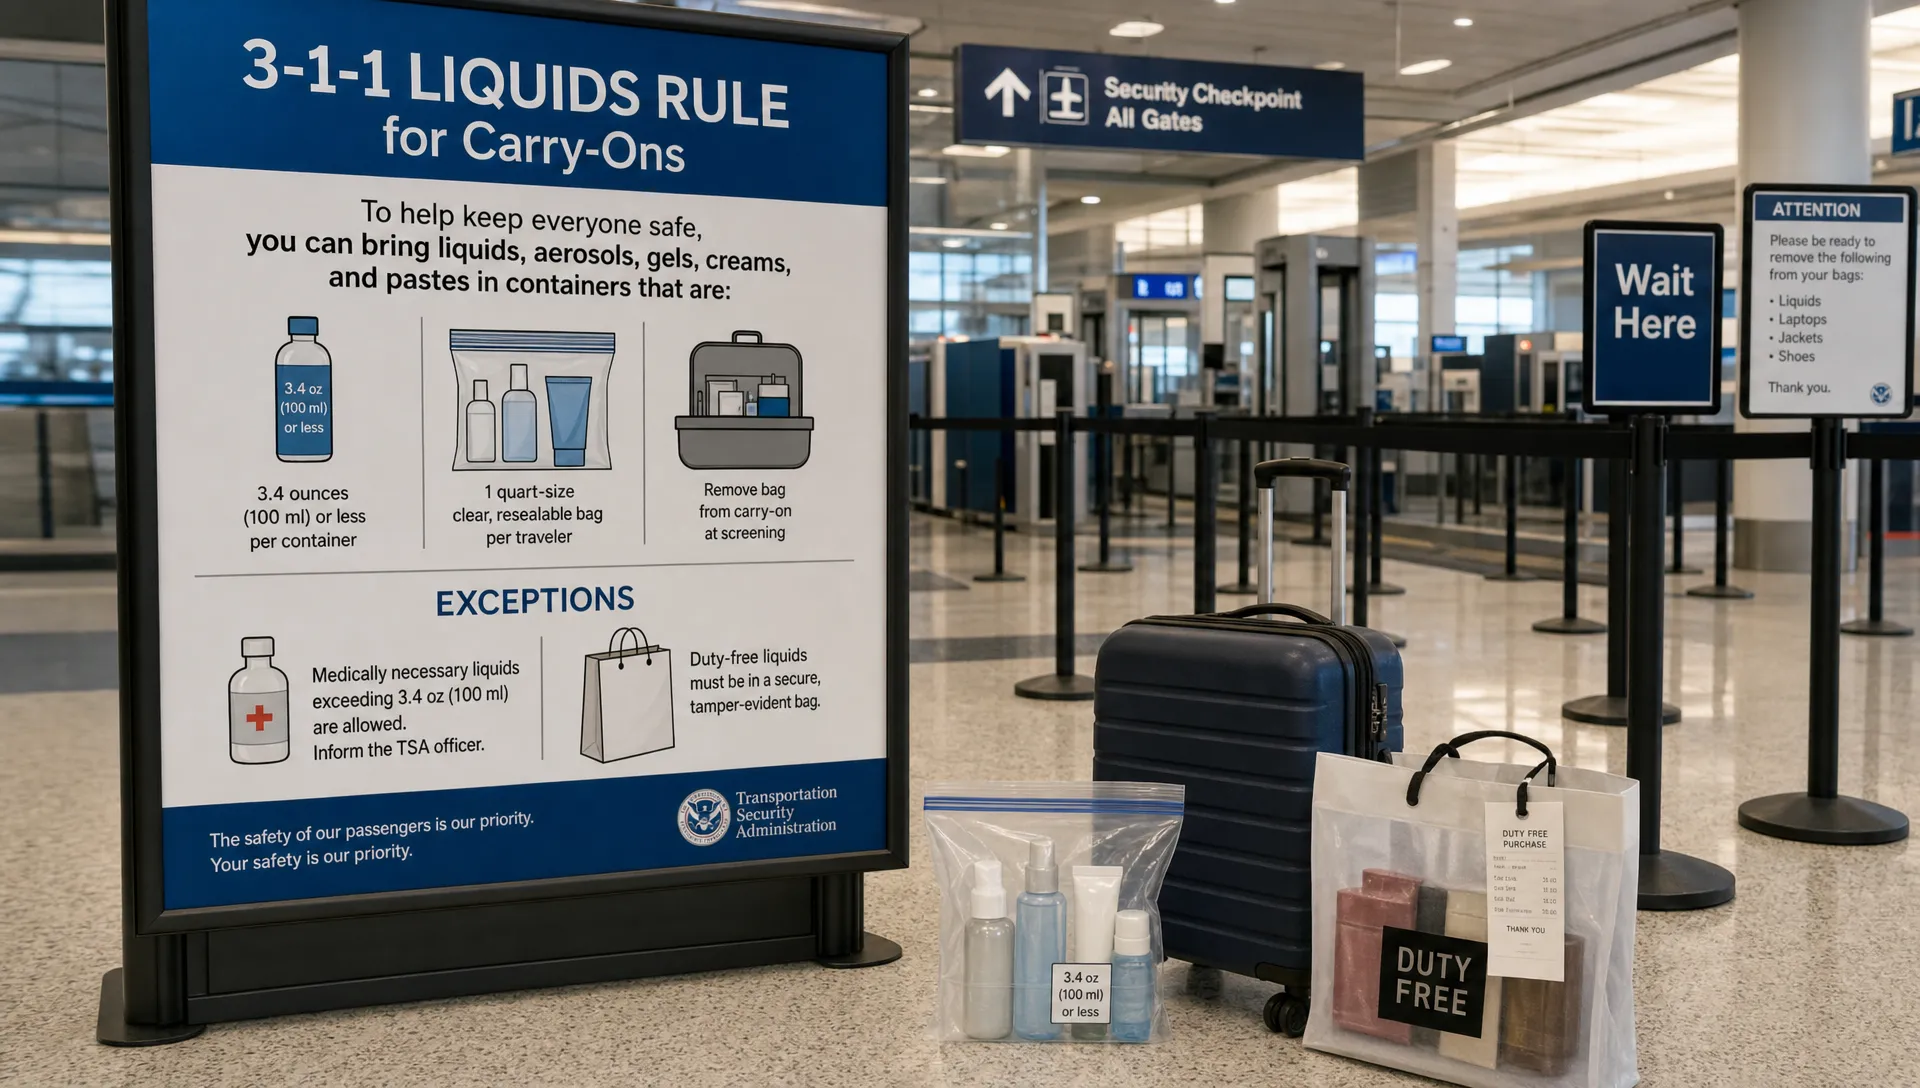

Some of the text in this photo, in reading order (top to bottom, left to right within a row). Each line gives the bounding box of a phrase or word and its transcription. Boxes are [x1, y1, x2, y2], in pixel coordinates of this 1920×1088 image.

[243, 38, 789, 128] 3-1-1 LIQUIDS RULE
[1192, 82, 1302, 111] Checkpoint
[1105, 106, 1203, 132] All Gates
[383, 115, 685, 175] for Carry-Ons
[1772, 202, 1861, 217] ATTENTION
[361, 199, 701, 242] To help keep everyone safe,
[1770, 234, 1876, 249] Please be ready to
[246, 232, 790, 277] you can bring liquids, aerosols, gels, creams,
[1770, 251, 1891, 266] remove the following
[329, 266, 730, 300] and pastes in containers that are:
[1615, 263, 1694, 296] Wait
[1769, 268, 1863, 284] from your bags:
[1779, 294, 1821, 309] Liquids
[1615, 306, 1696, 339] Here
[1779, 313, 1827, 328] Laptops
[1778, 331, 1823, 344] Jackets
[1779, 350, 1815, 362] Shoes
[285, 382, 323, 395] 3.4 oz
[1768, 381, 1831, 396] Thank you.
[280, 401, 327, 416] (100 ml)
[284, 421, 324, 433] or less
[258, 486, 349, 501] 3.4 ounces
[485, 484, 574, 503] 1 quart-size
[705, 482, 785, 499] Remove bag
[244, 508, 366, 528] (100 ml) or less
[453, 506, 603, 524] clear, resealable bag
[699, 504, 792, 521] from carry-on
[250, 532, 357, 552] per container
[487, 529, 573, 548] per traveler
[705, 525, 785, 542] at screening
[437, 585, 634, 616] EXCEPTIONS
[691, 647, 807, 669] Duty-free liquids
[313, 660, 520, 684] Medically necessary liquids
[690, 673, 821, 690] must be in a secure,
[313, 684, 508, 710] exceeding 3.4 oz (100 ml)
[690, 694, 820, 716] tamper-evident bag.
[313, 715, 406, 735] are allowed.
[314, 737, 484, 760] Inform the TSA officer.
[736, 786, 837, 806] Transportation
[737, 806, 794, 822] Security
[209, 811, 534, 848] The safety of our passengers is our priority.
[736, 819, 836, 838] Administration
[1503, 830, 1548, 838] DUTY FREE
[1503, 840, 1546, 848] PURCHASE
[210, 844, 412, 872] Your safety is our priority.
[1506, 925, 1529, 933] THANK
[1398, 946, 1472, 982] DUTY
[1064, 971, 1099, 983] 3.4 oz
[1059, 988, 1103, 1002] (100 ml)
[1396, 978, 1468, 1016] FREE
[1062, 1006, 1099, 1017] or less
